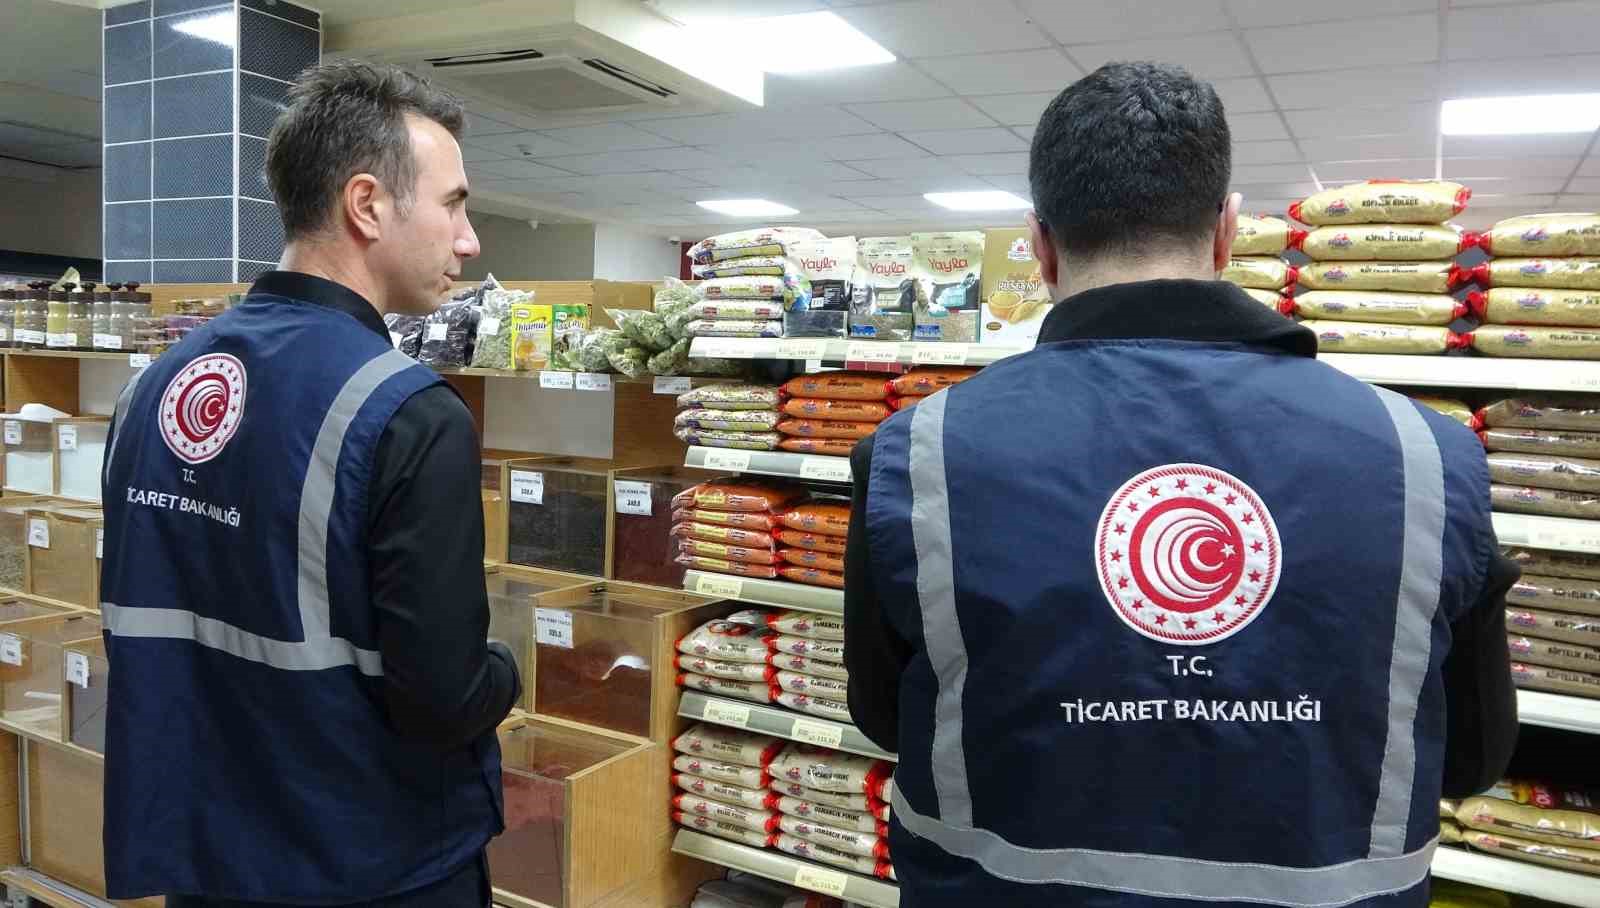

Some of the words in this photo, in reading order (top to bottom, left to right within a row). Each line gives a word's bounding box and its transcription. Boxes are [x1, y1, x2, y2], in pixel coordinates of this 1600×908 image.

[800, 255, 838, 272] Yayla
[869, 261, 906, 277] Yayla
[927, 256, 968, 274] Yayla
[179, 496, 241, 528] BAKANLIĞI
[1166, 655, 1213, 677] T.C.
[1060, 698, 1168, 723] TİCARET
[1174, 694, 1321, 722] BAKANLIĞI
